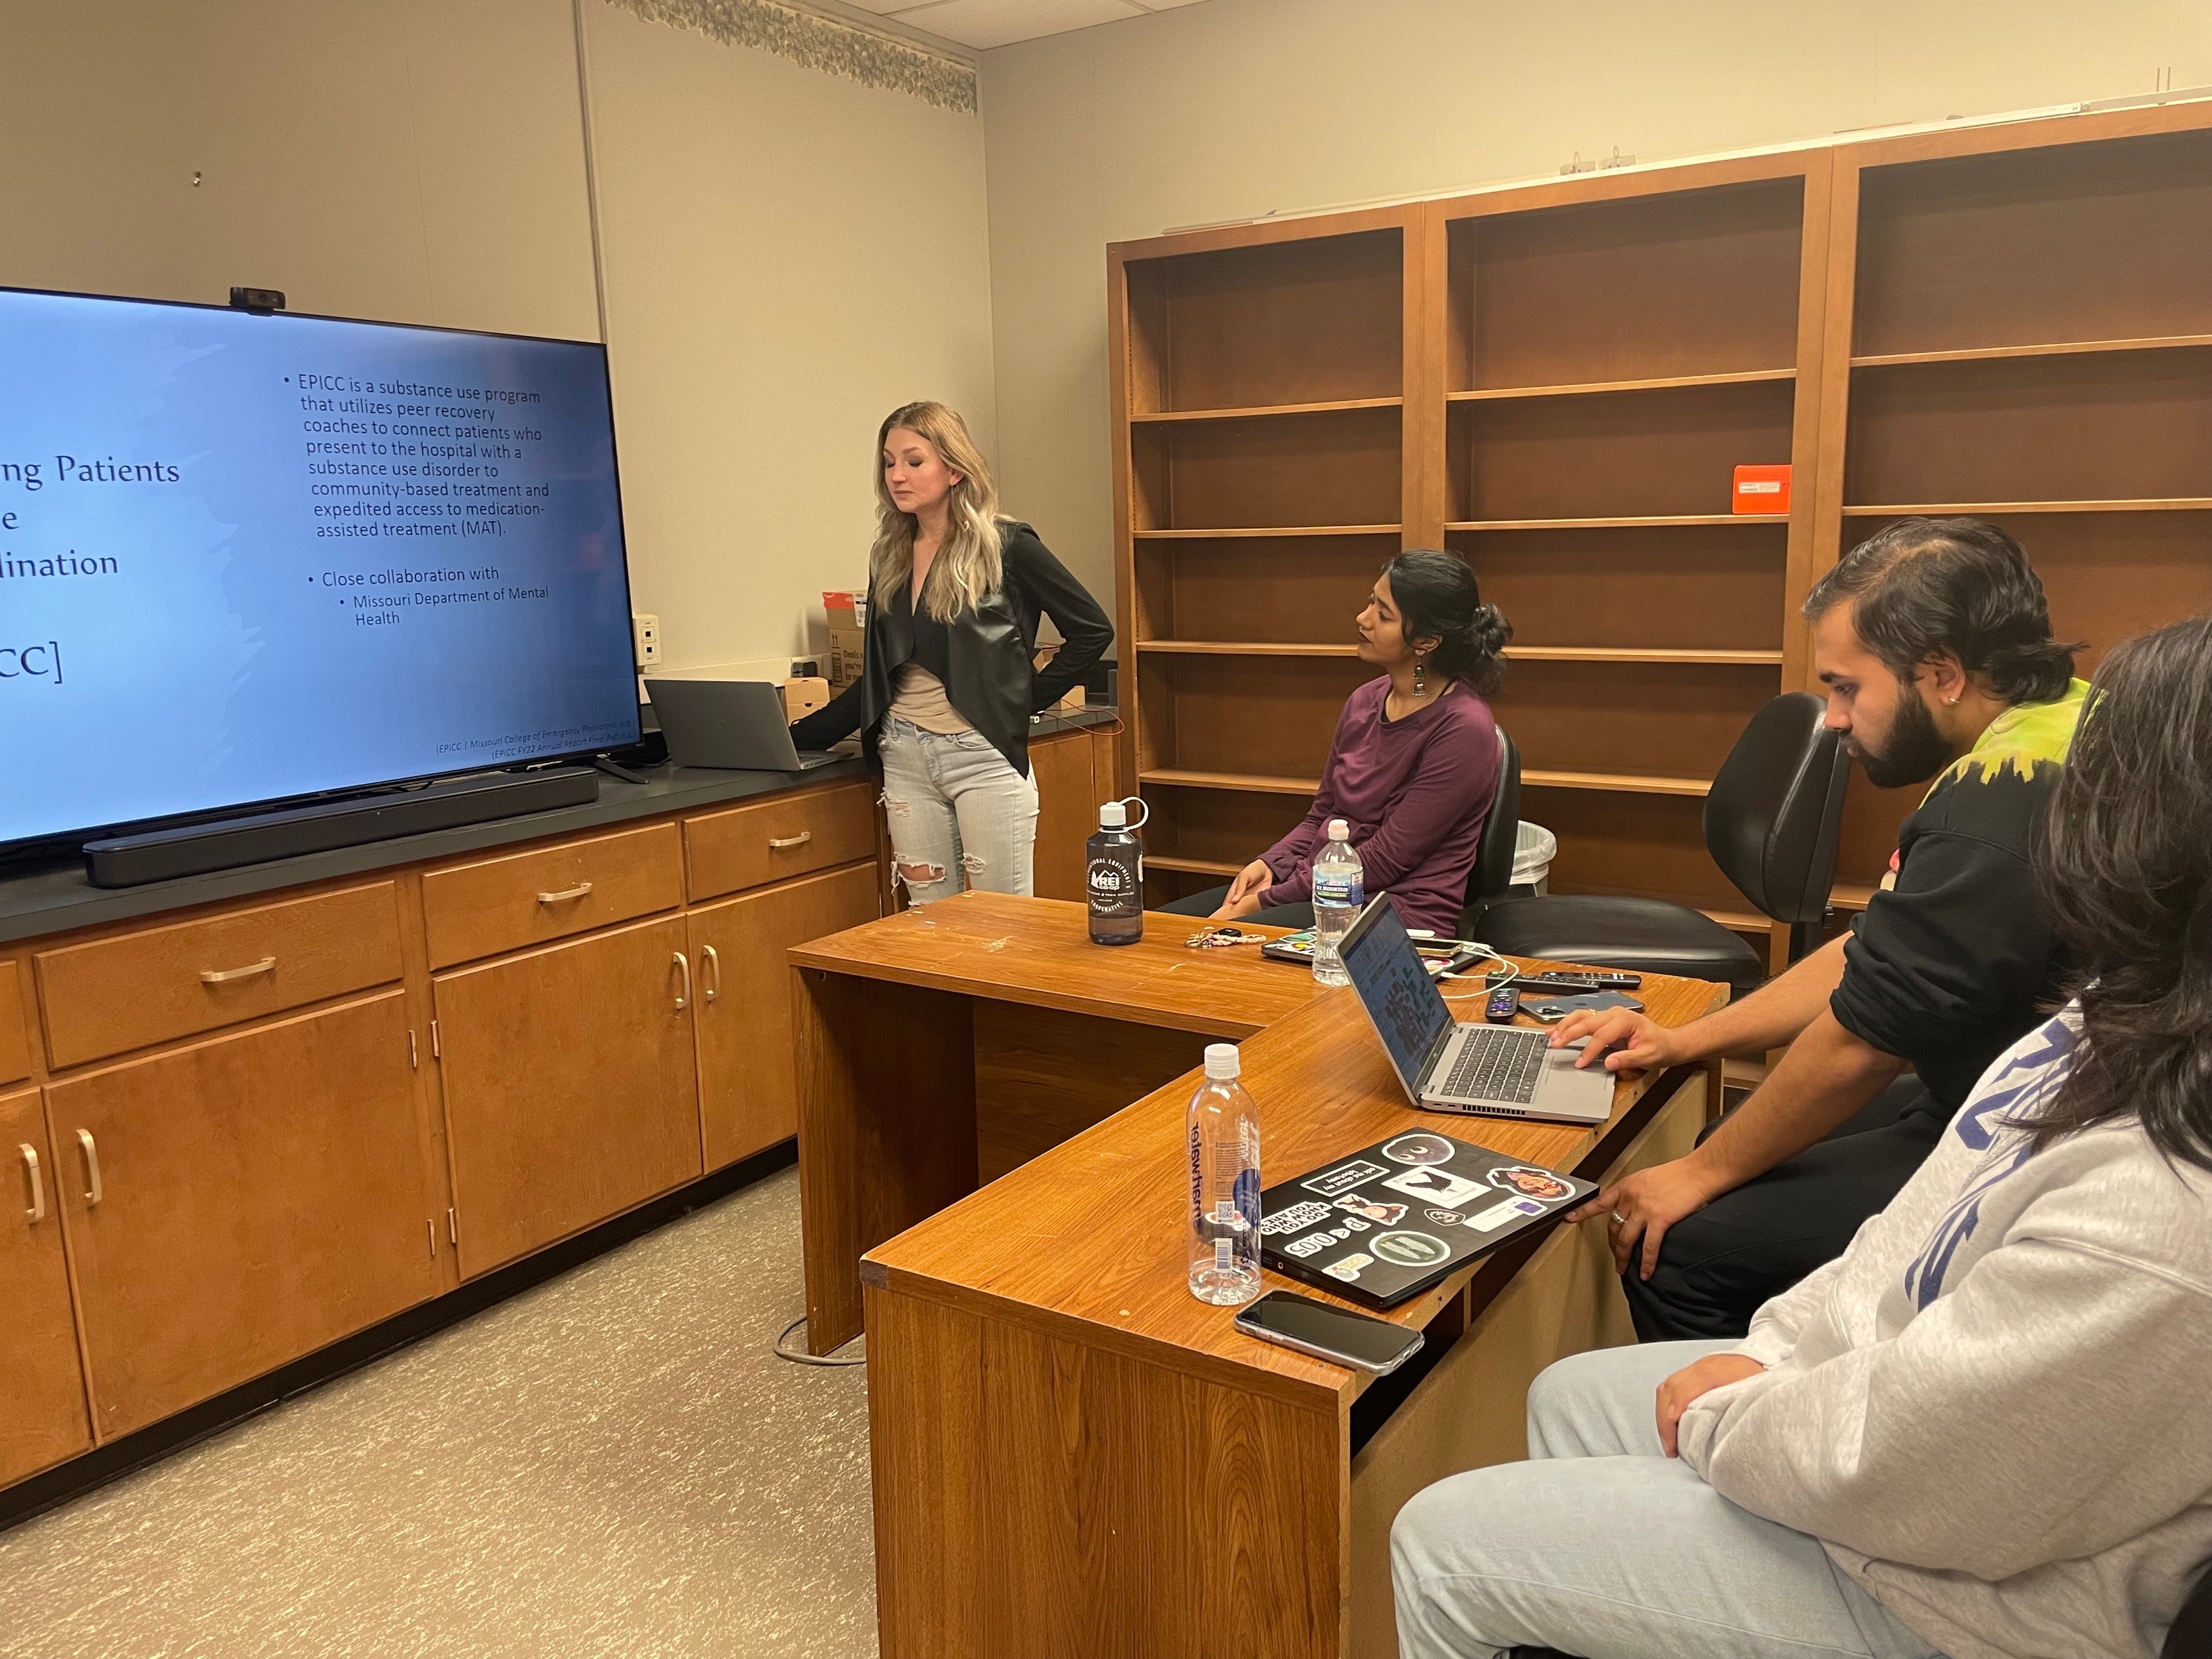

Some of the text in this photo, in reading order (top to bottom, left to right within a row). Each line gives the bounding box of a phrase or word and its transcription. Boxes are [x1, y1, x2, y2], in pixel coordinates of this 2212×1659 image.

[299, 374, 541, 405] EPICC is a substance use program
[300, 396, 495, 422] that utilizes peer recovery
[304, 418, 541, 441] coaches to connect patients who
[306, 440, 522, 459] present to the hospital with a
[54, 455, 180, 483] Patients
[309, 460, 498, 477] substance use disorder to
[312, 481, 549, 499] community-based treatment and
[314, 500, 544, 518] expedited access to medication-
[2, 512, 20, 530] e
[316, 518, 506, 538] assisted treatment (MAT).
[322, 566, 499, 587] Close collaboration with
[353, 586, 549, 609] Missouri Department of Mental
[355, 611, 400, 626] Health
[436, 741, 462, 755] (EPICC
[470, 738, 503, 749] Missouri
[504, 733, 531, 745] College
[533, 731, 541, 741] of
[542, 726, 580, 739] Emergency
[492, 748, 516, 760] (EPICC
[517, 745, 535, 756] FY22
[537, 742, 562, 752] Annual
[564, 738, 587, 749] Report
[1099, 877, 1120, 886] REI
[1262, 1204, 1328, 1232] KNOW WHO
[1288, 1204, 1315, 1214] YOU
[1282, 1212, 1326, 1231] DO YOU
[1290, 1235, 1332, 1255] 0.05
